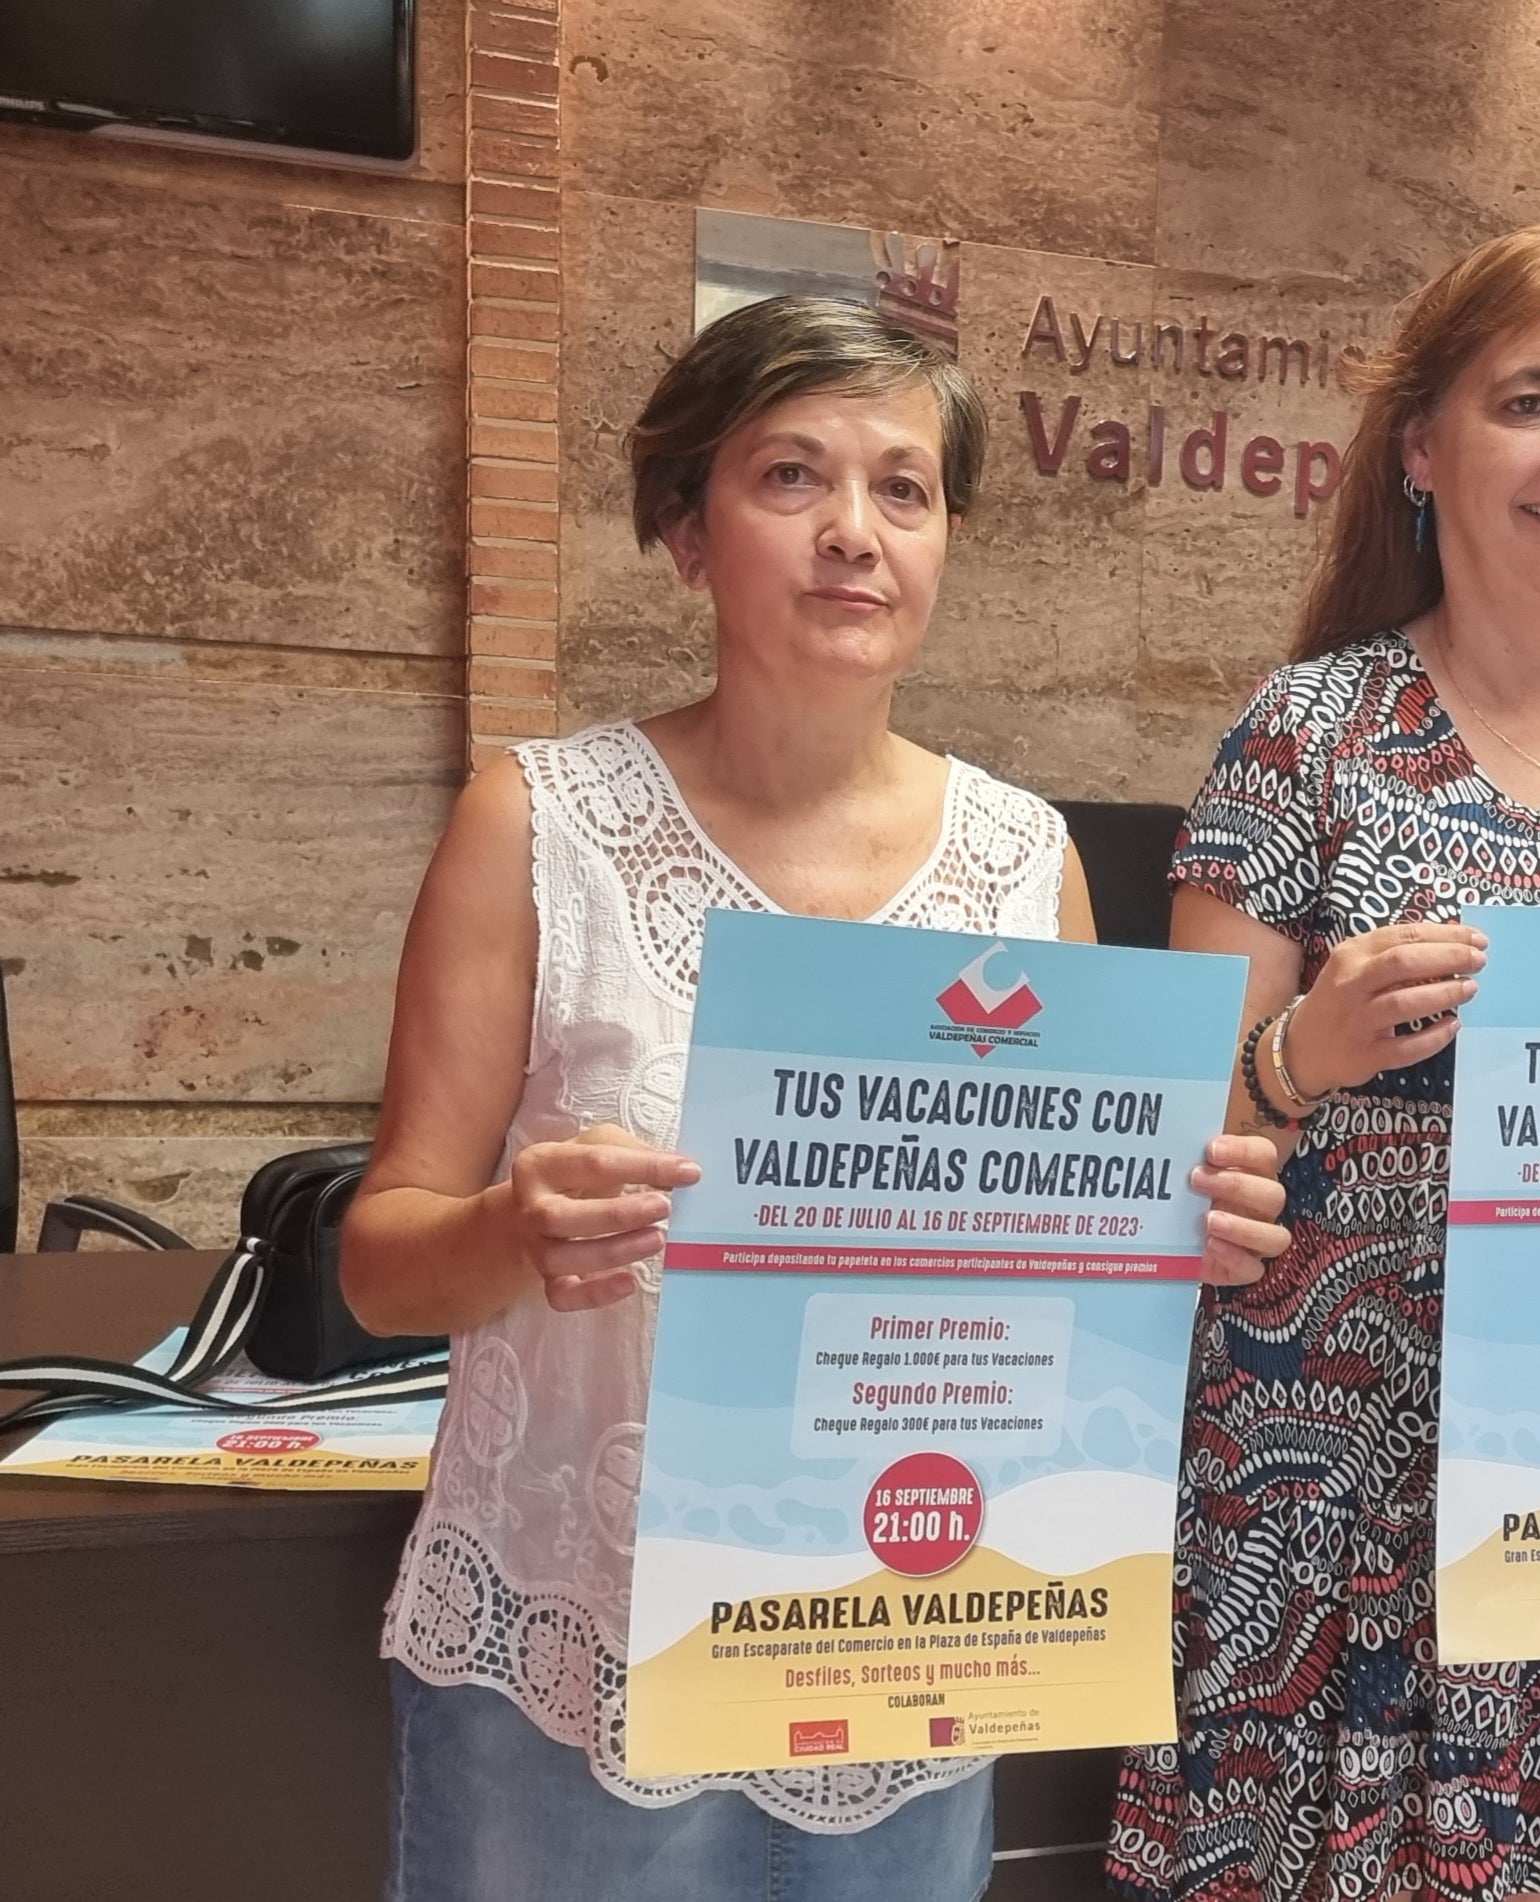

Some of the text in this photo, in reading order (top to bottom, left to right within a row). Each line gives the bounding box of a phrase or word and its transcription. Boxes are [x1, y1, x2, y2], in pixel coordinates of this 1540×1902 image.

[1021, 295, 1331, 389] Ayuntami
[1020, 390, 1344, 520] Valdep
[772, 1067, 1164, 1138] TUS VACACIONES CON
[733, 1132, 1173, 1202] VALDEPEÑAS COMERCIAL
[792, 1204, 819, 1229] 20
[820, 1205, 846, 1230] DE
[846, 1206, 894, 1231] JULIO
[894, 1207, 918, 1232] AL
[921, 1208, 944, 1232] 16
[946, 1209, 970, 1233] DE
[970, 1210, 1073, 1236] SEPTIEMBRE
[1073, 1213, 1096, 1237] DE
[869, 1314, 1011, 1342] Primer Premio:
[814, 1350, 861, 1370] Cheque
[860, 1350, 903, 1370] Regalo
[941, 1352, 970, 1371] para
[970, 1351, 990, 1367] tus
[990, 1350, 1055, 1368] Vacaciones
[851, 1379, 1014, 1413] Segundo Premio:
[812, 1414, 1045, 1436] Cheque Regalo 300€ para tus Vacaciones
[70, 1454, 224, 1466] PASARELA
[236, 1457, 419, 1470] VALDEPEÑAS
[874, 1486, 976, 1508] 16 SEPTIEMBRE
[871, 1509, 971, 1544] 21:00 h.
[710, 1579, 1110, 1636] PASARELA VALDEPEÑAS
[710, 1624, 1107, 1662] Gran Escaparate del Comercio en la Plaza de España de Valdepeñas
[784, 1664, 857, 1690] Desfiles,
[860, 1663, 922, 1685] Sorteos
[924, 1662, 936, 1688] y
[938, 1658, 993, 1681] mucho
[886, 1691, 946, 1710] COLABORAN
[967, 1719, 1042, 1736] Valdepeñas
